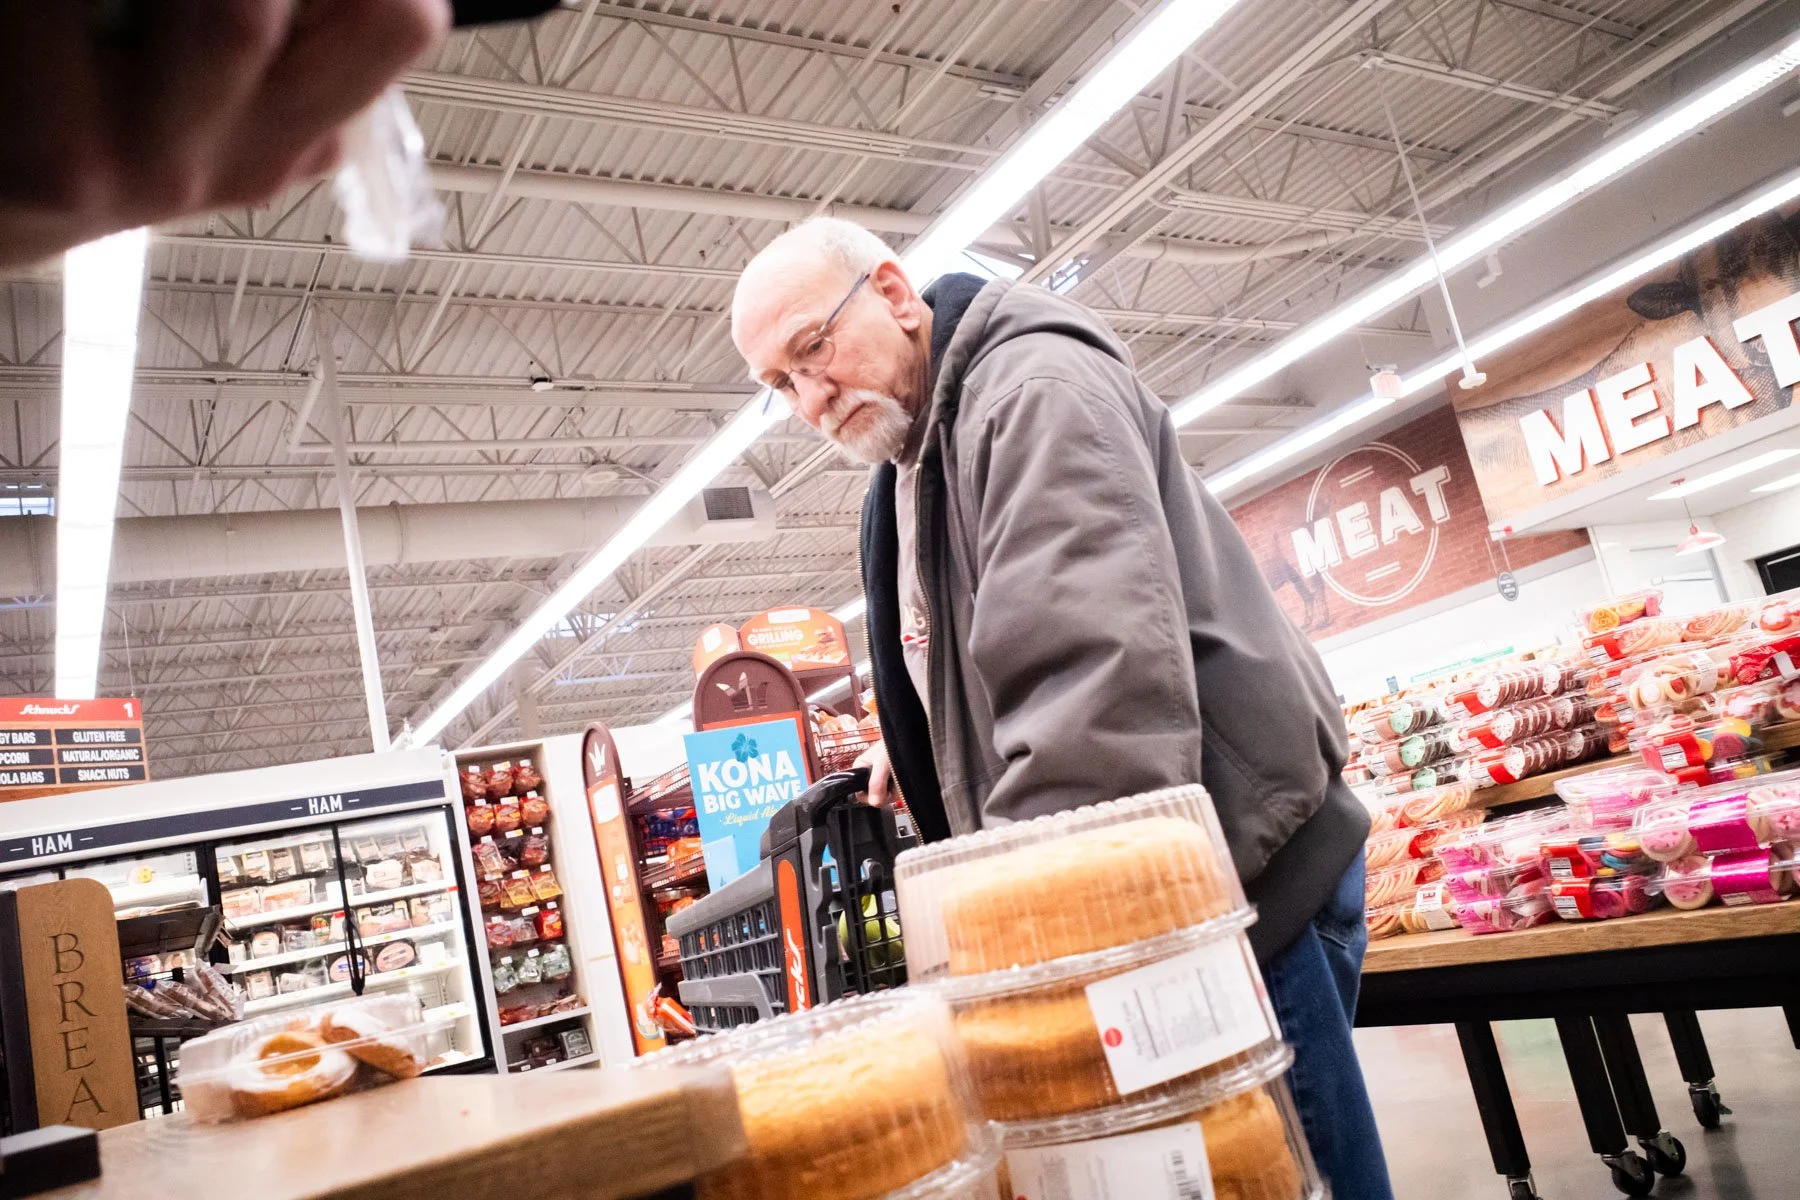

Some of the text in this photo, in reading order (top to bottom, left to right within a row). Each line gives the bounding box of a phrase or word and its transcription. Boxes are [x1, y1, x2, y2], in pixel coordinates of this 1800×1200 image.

[1519, 290, 1800, 487] MEAT
[1290, 465, 1451, 578] MEAT
[19, 704, 80, 715] Schnucks
[123, 702, 134, 718] 1
[12, 732, 36, 744] BARS
[72, 730, 126, 743] GLUTEN FREE
[62, 749, 140, 762] NATURAL/ORGANIC
[20, 771, 45, 784] BARS
[77, 768, 129, 781] SNACK NUTS
[697, 750, 799, 793] KONA
[307, 794, 343, 815] HAM
[703, 779, 801, 815] BIG WAVE
[723, 810, 760, 827] Liquid
[31, 833, 74, 856] HAM
[48, 932, 108, 1124] BREA
